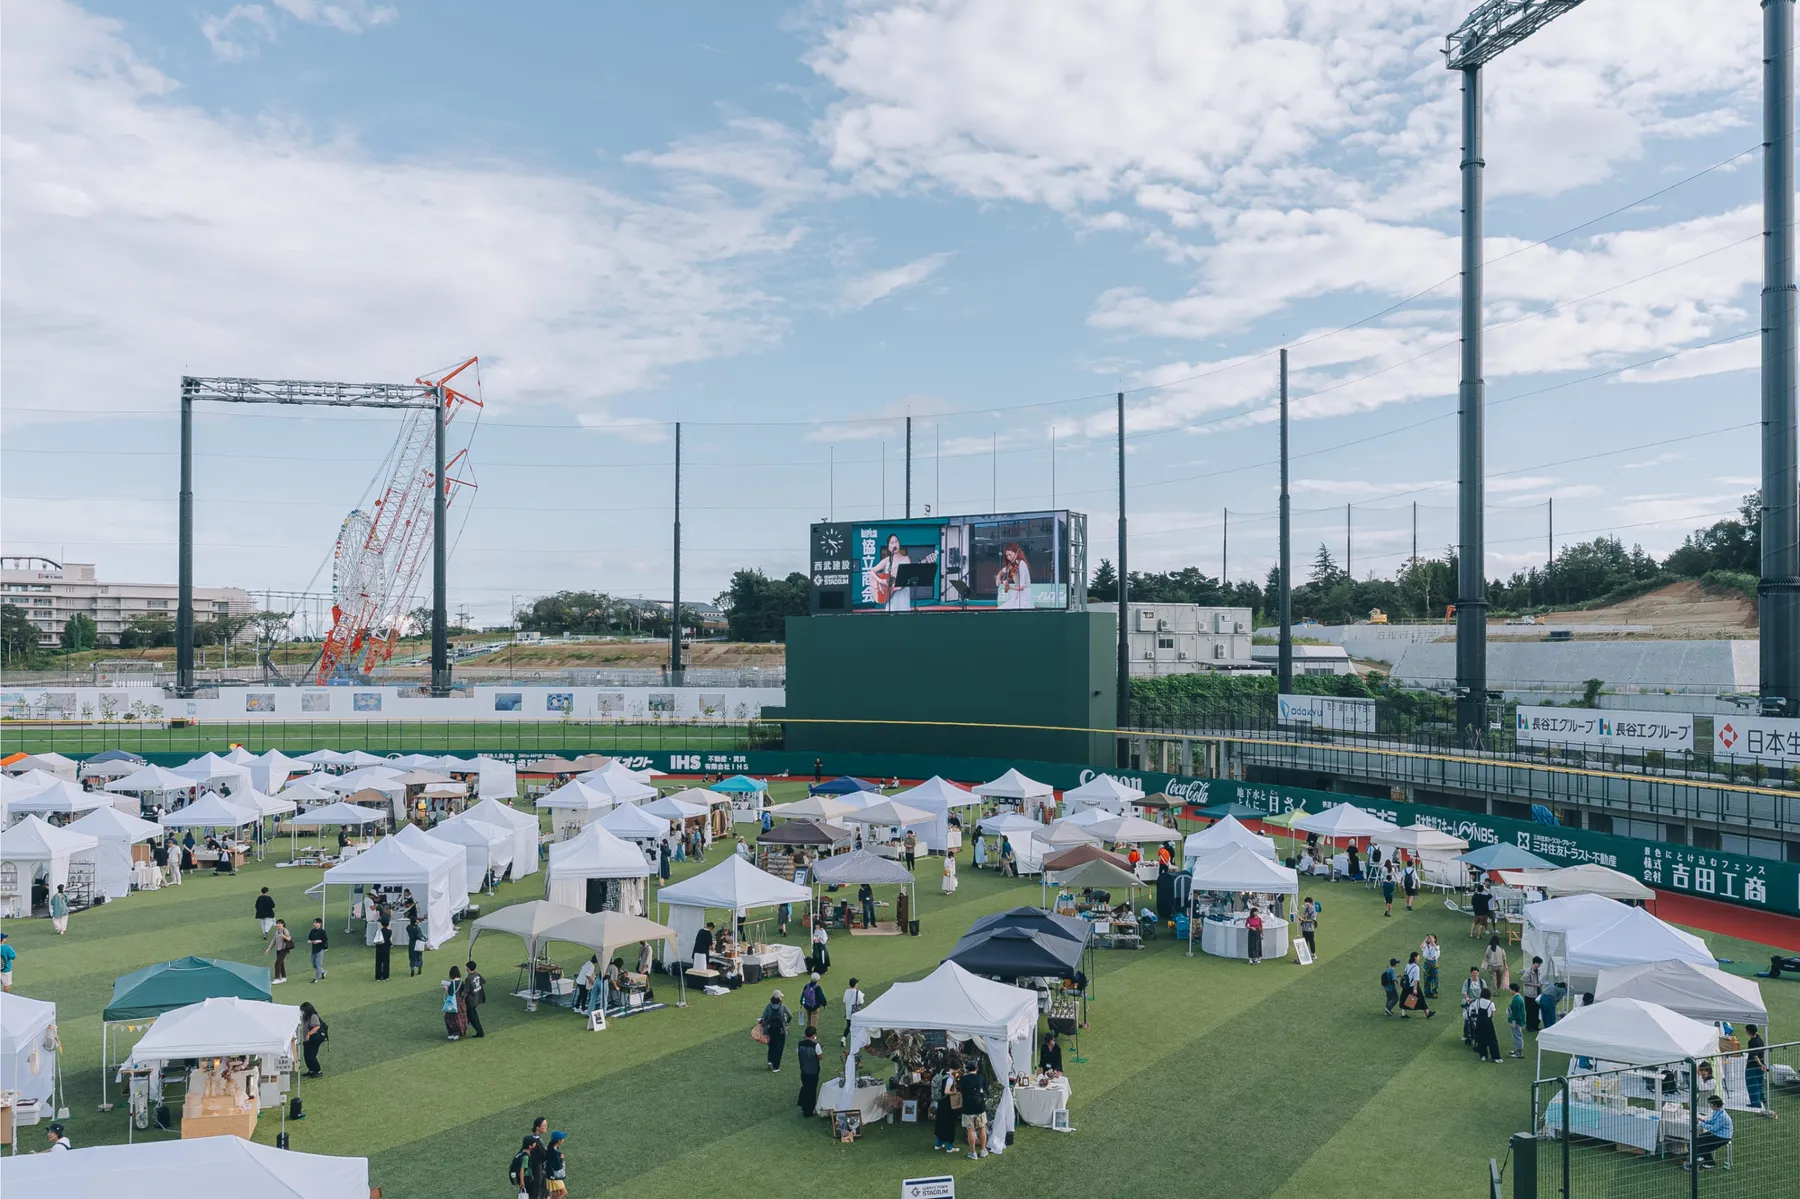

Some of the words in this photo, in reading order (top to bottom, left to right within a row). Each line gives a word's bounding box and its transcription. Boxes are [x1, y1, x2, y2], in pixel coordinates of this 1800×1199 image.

[1291, 706, 1323, 716] odakyu
[1532, 717, 1595, 734] 長谷工グループ
[1616, 722, 1691, 741] 長谷工グループ
[1748, 729, 1800, 756] 日本生
[670, 755, 701, 770] IHS
[1533, 841, 1617, 867] 三井住友トラスト不動産
[1672, 863, 1767, 903] 吉田工商
